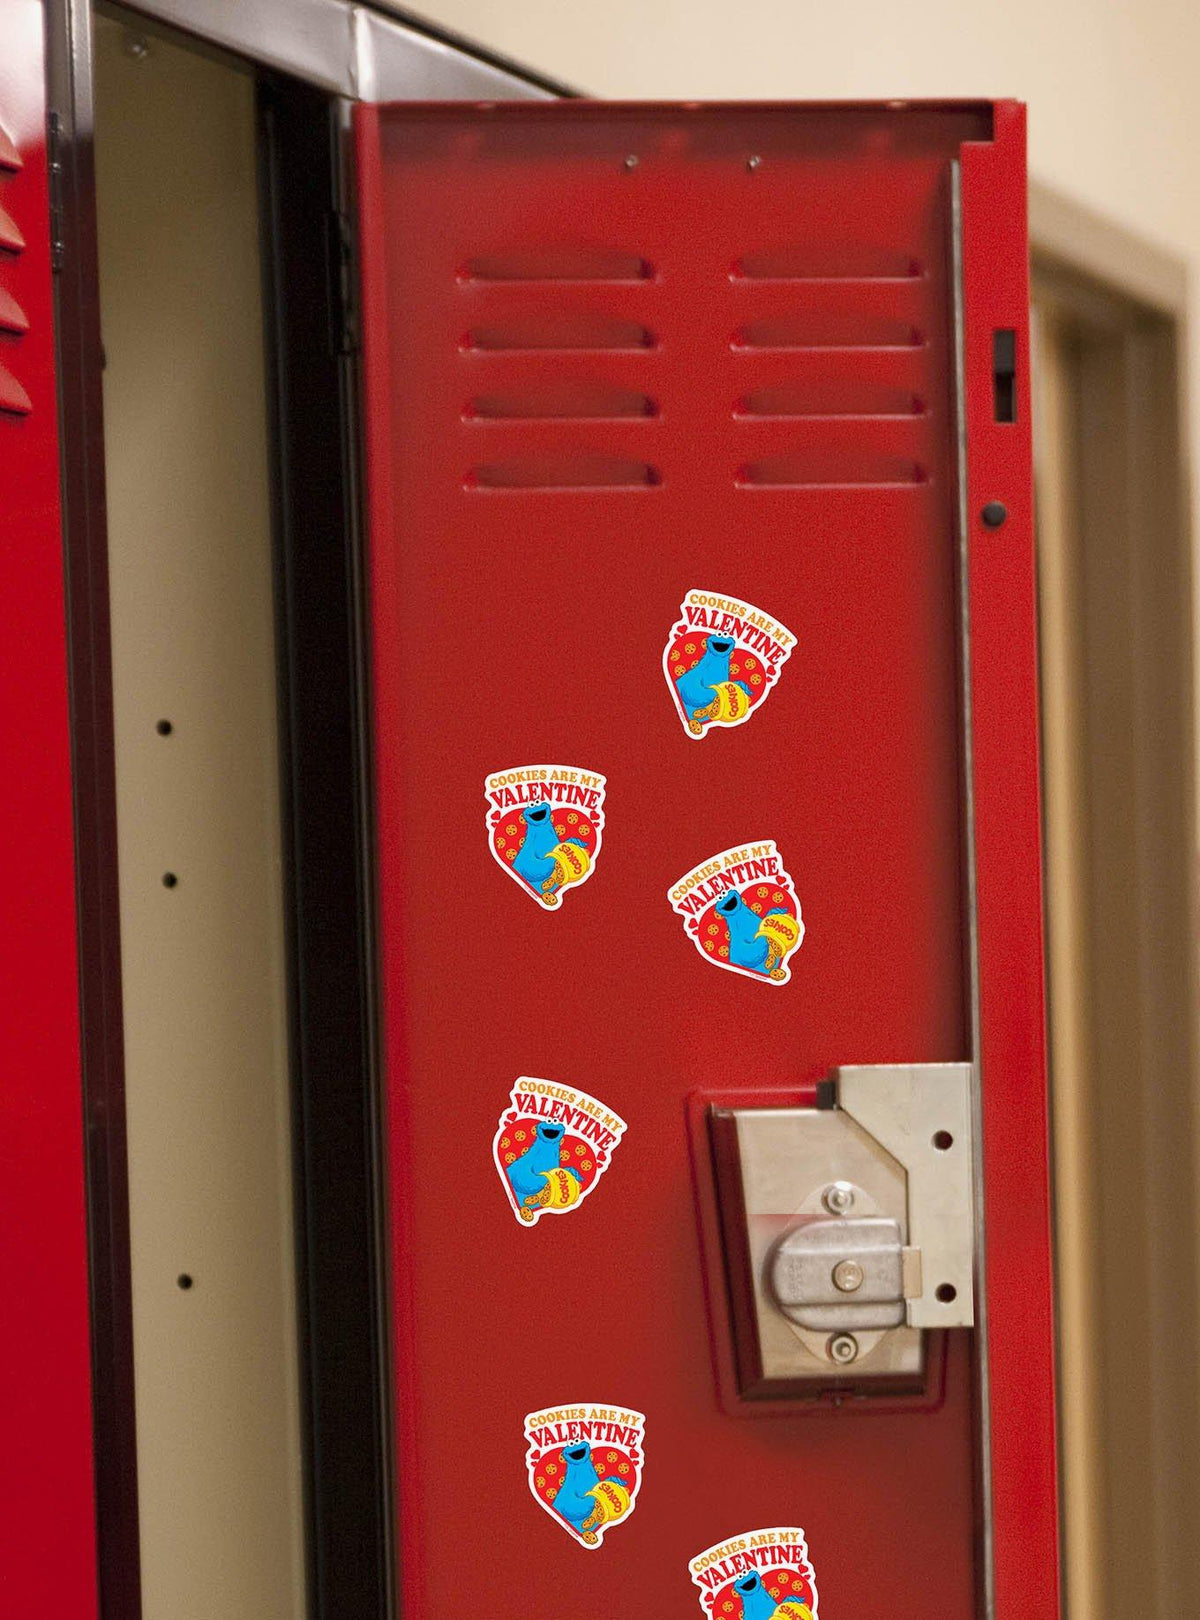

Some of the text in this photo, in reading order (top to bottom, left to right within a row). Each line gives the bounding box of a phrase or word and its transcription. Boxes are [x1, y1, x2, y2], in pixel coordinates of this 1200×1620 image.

[685, 606, 787, 665] VALENTINE
[689, 593, 793, 647] COOKIES ARE MY
[489, 769, 601, 789] COOKIES ARE MY
[489, 782, 601, 810] VALENTINE
[672, 844, 772, 901] COOKIES ARE MY
[678, 856, 779, 915] VALENTINE
[514, 1093, 617, 1151] VALENTINE
[518, 1080, 623, 1133] COOKIES ARE MY
[528, 1408, 641, 1428] COOKIES ARE MY
[528, 1421, 640, 1449] VALENTINE
[693, 1531, 800, 1572] COOKIES ARE MY
[696, 1544, 803, 1589] VALENTINE
